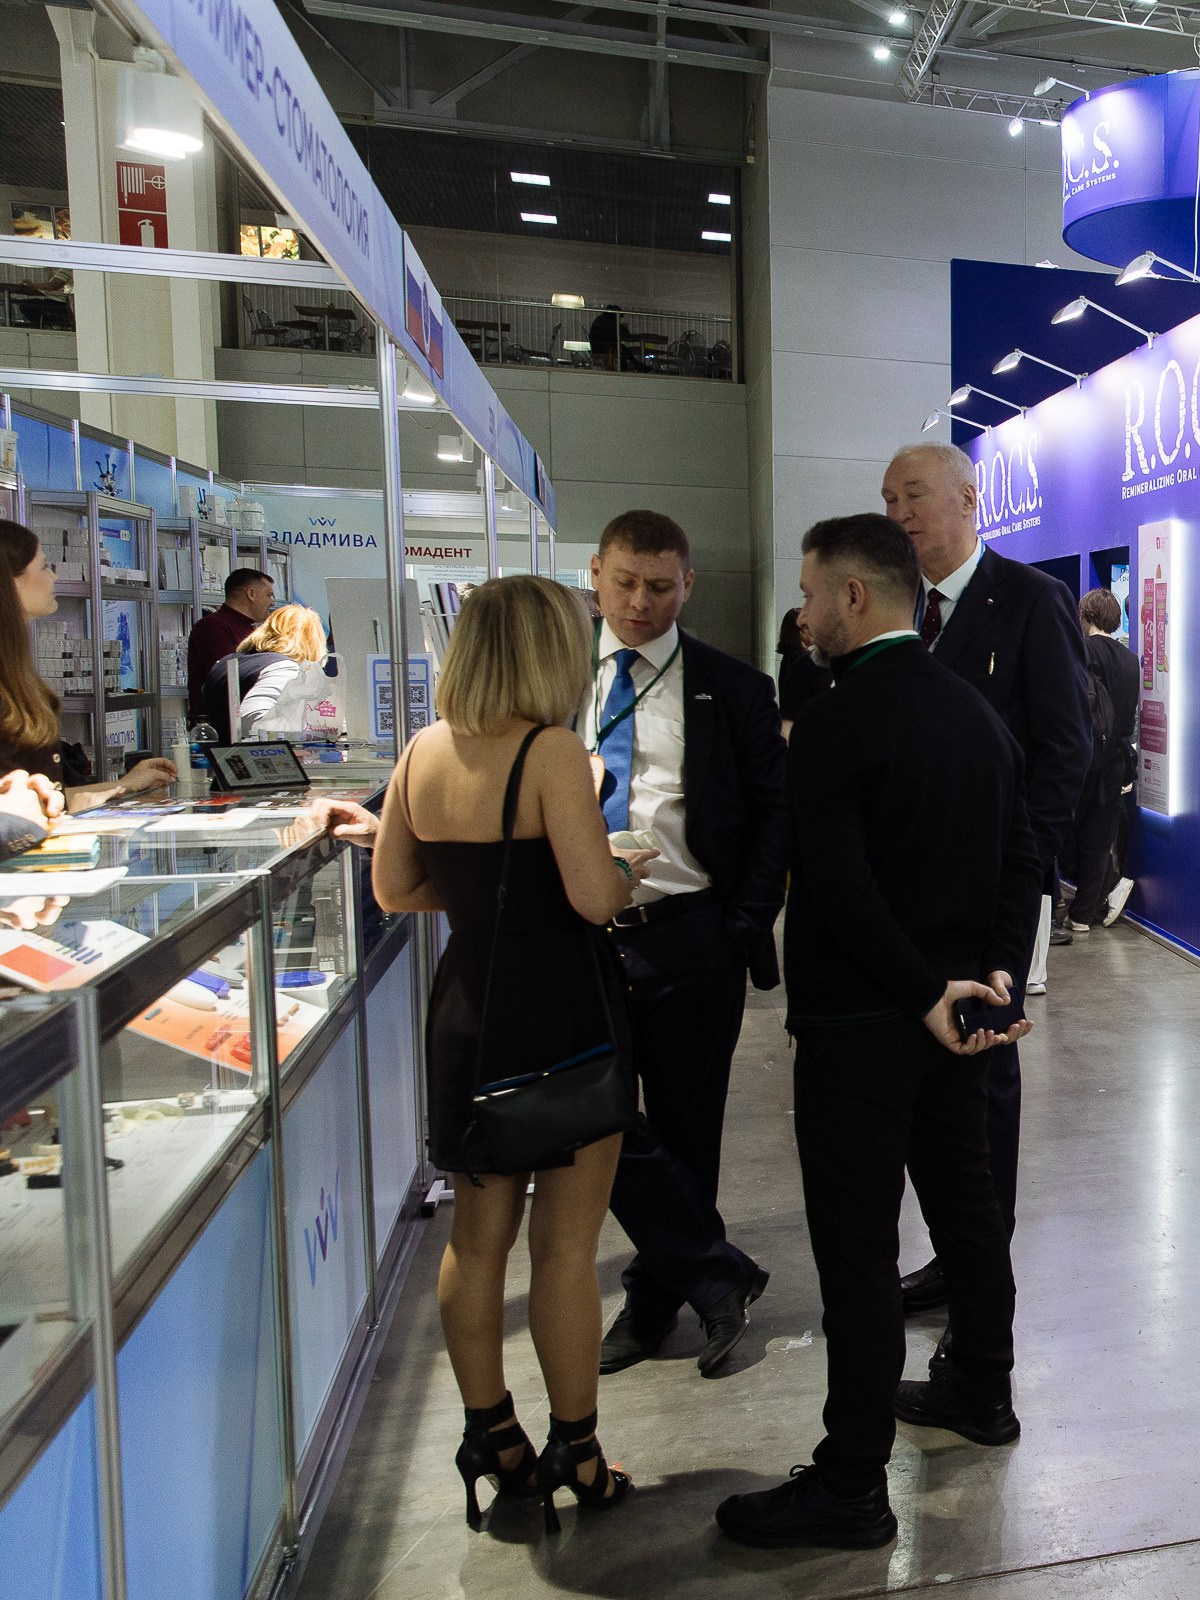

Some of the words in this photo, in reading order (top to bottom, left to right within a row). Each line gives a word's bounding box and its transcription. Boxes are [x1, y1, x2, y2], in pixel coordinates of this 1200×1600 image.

[1086, 172, 1116, 188] SYSTEMS
[1122, 471, 1175, 500] REMINERALIZING
[1176, 463, 1197, 485] ORAL
[1023, 516, 1041, 530] SYSTEMS
